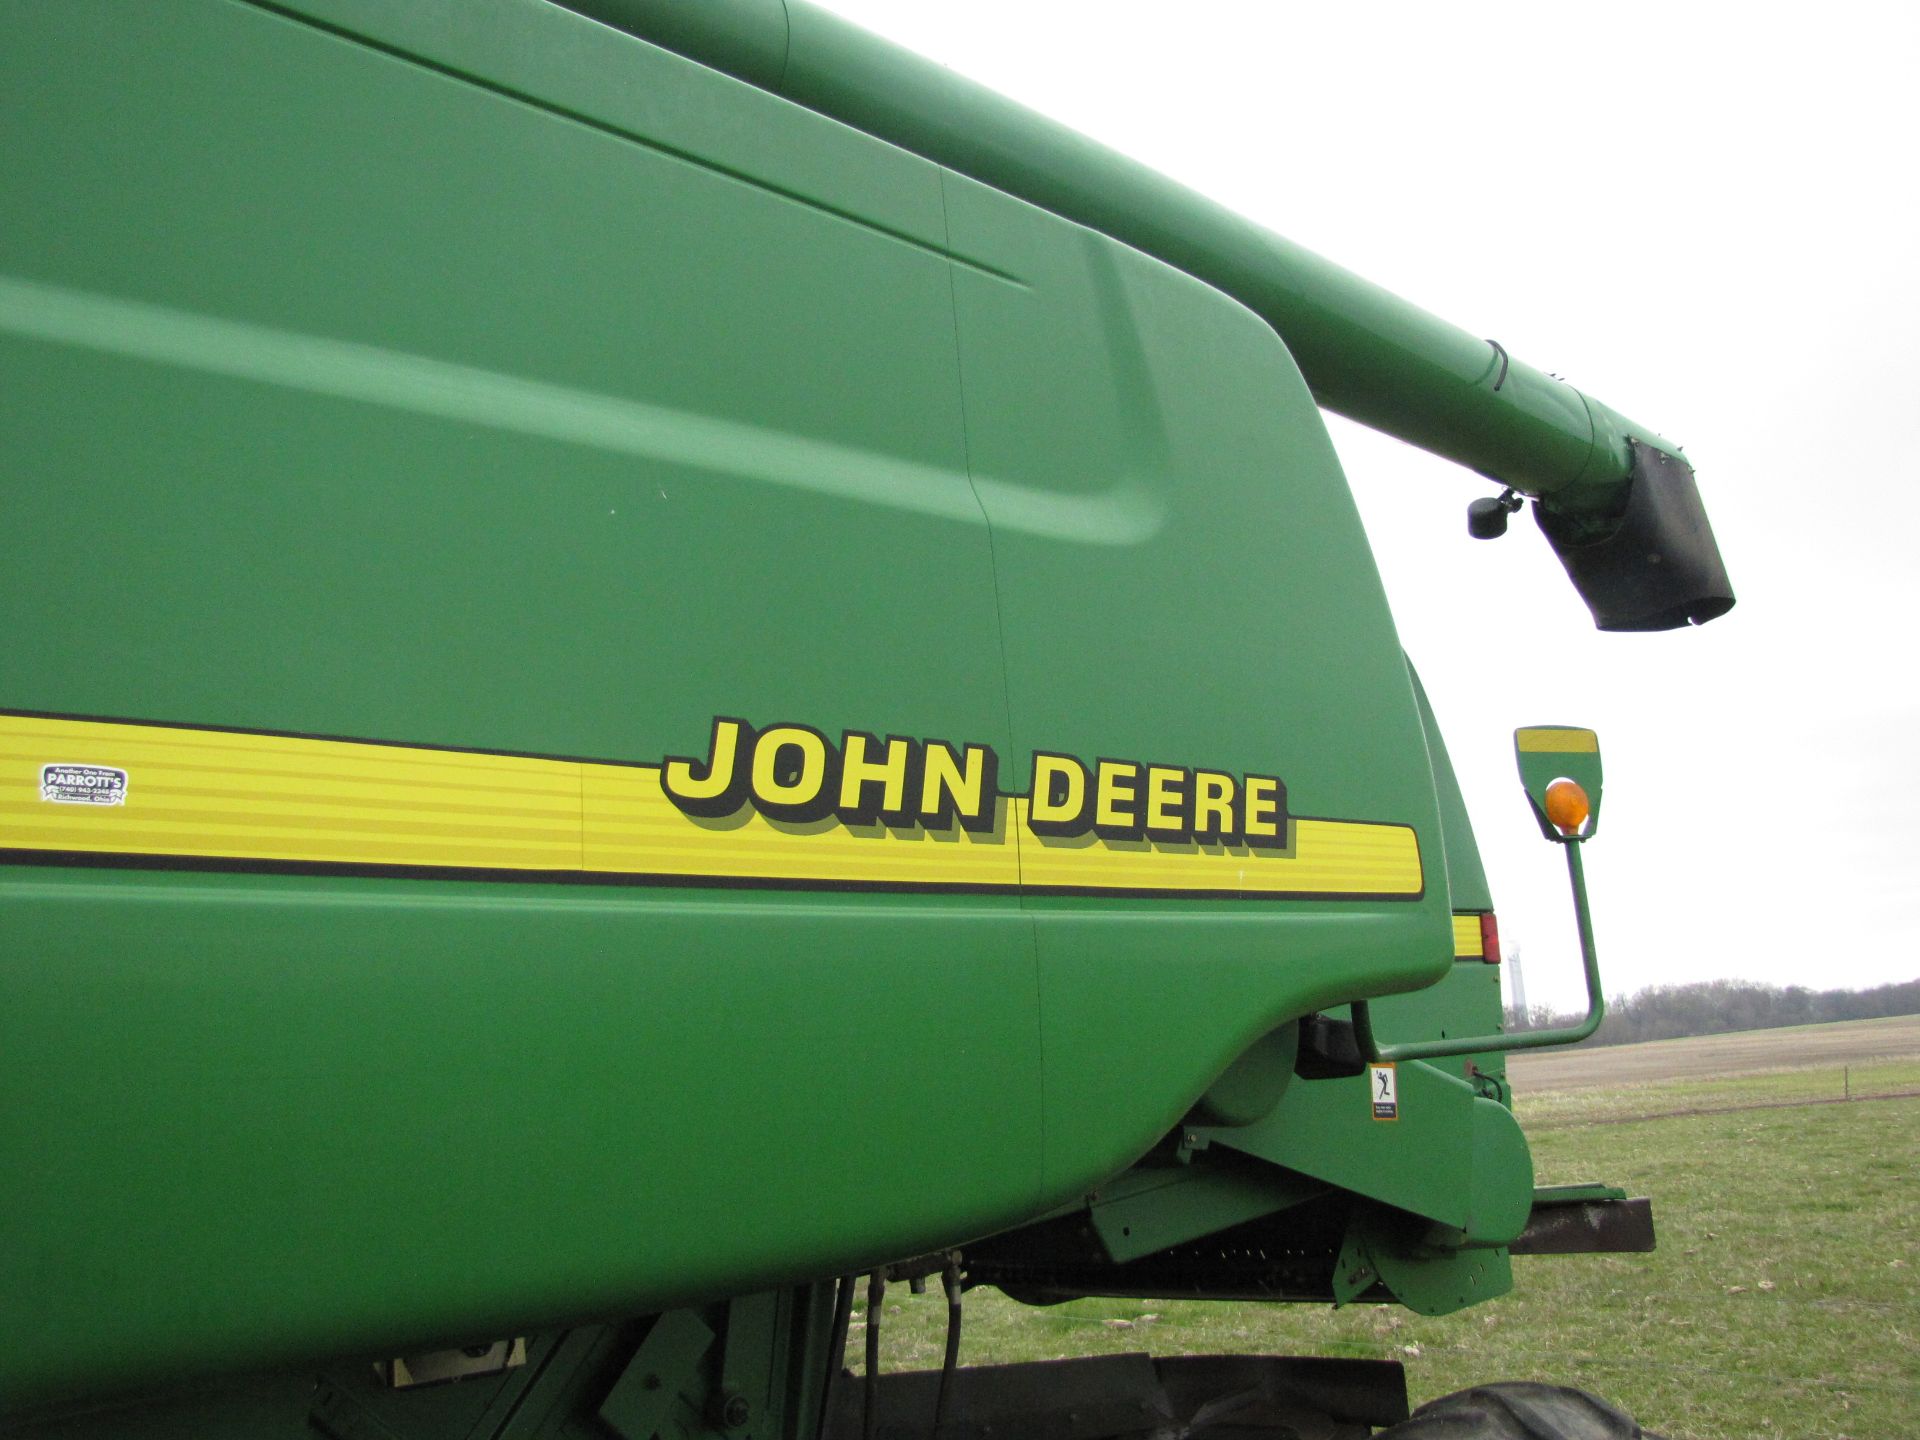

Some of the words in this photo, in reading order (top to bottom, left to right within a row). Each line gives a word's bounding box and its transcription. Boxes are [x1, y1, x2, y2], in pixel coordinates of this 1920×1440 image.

[54, 767, 82, 775] Another
[83, 768, 97, 776] One
[664, 719, 987, 822] JOHN
[1030, 752, 1279, 839] DEERE
[47, 773, 122, 789] PARROTT'S
